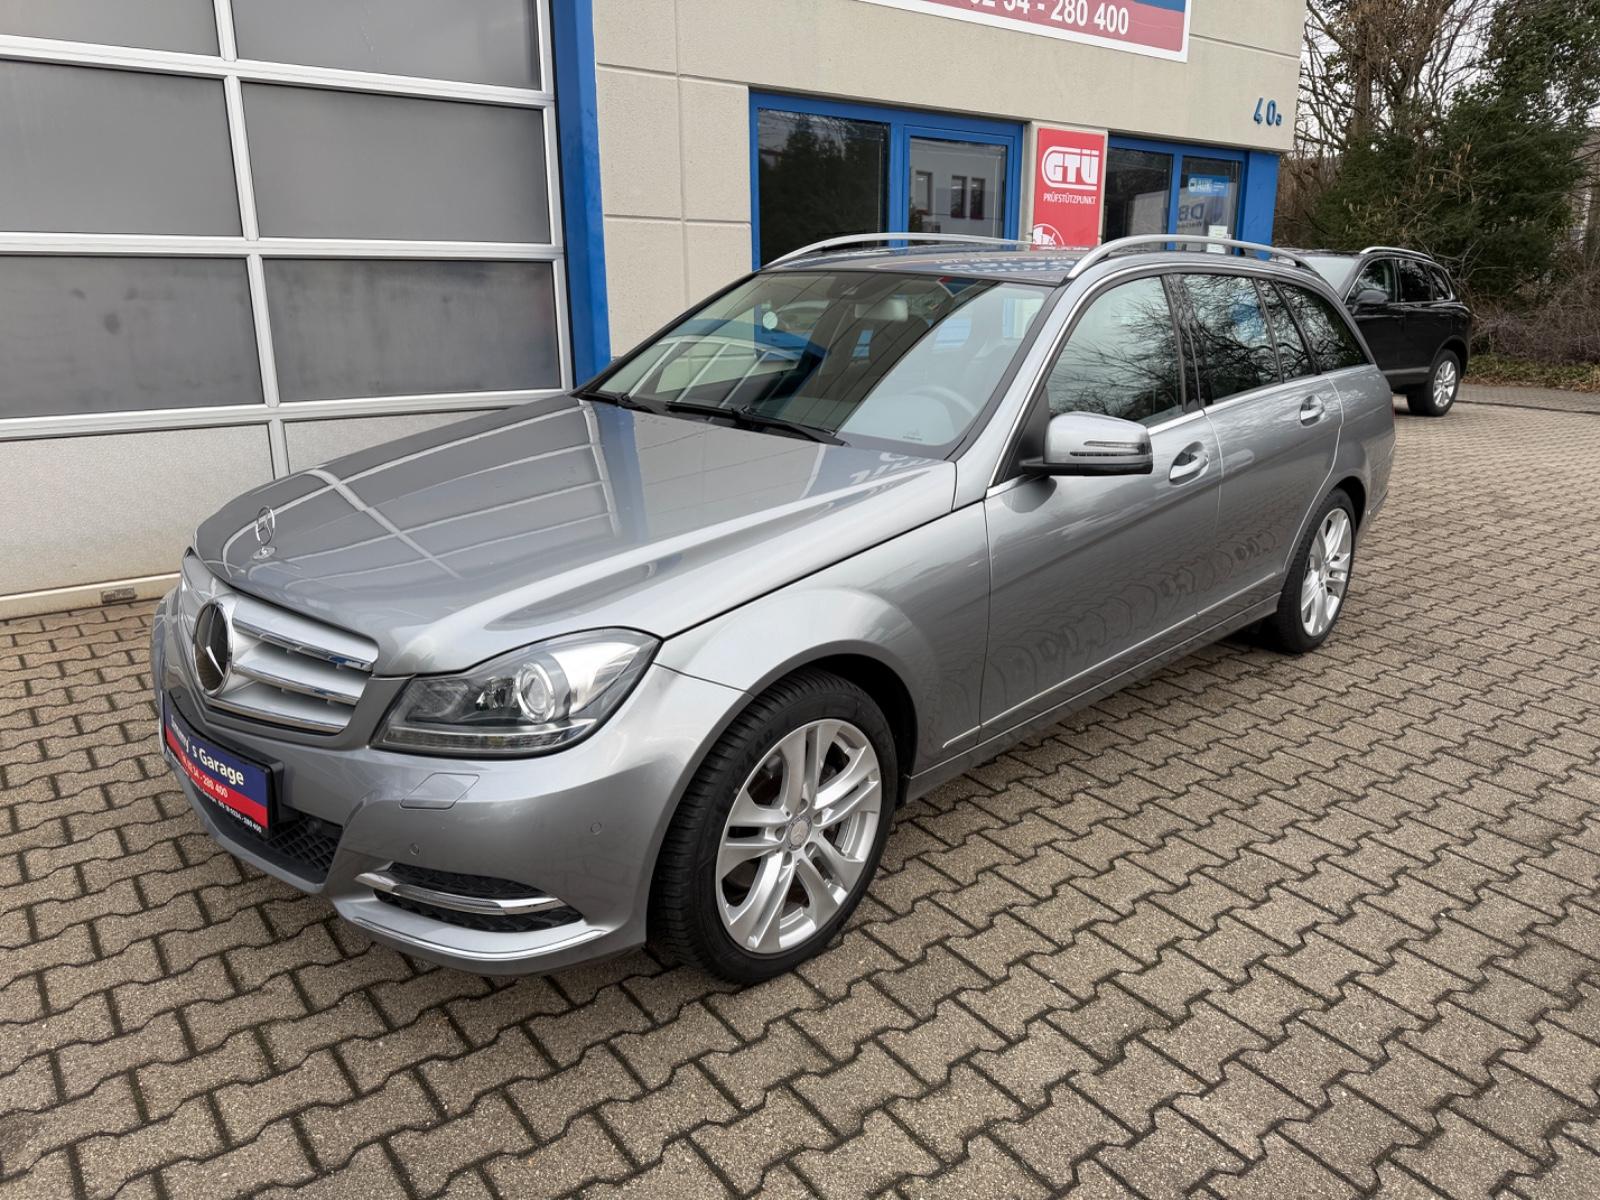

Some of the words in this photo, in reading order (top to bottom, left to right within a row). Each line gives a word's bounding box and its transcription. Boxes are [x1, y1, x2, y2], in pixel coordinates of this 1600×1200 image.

[1051, 0, 1088, 26] 280
[1094, 3, 1129, 35] 400
[1045, 147, 1099, 185] GTÜ
[1043, 191, 1097, 205] PRÜFSTÜTZPUNKT
[199, 748, 244, 785] Garage
